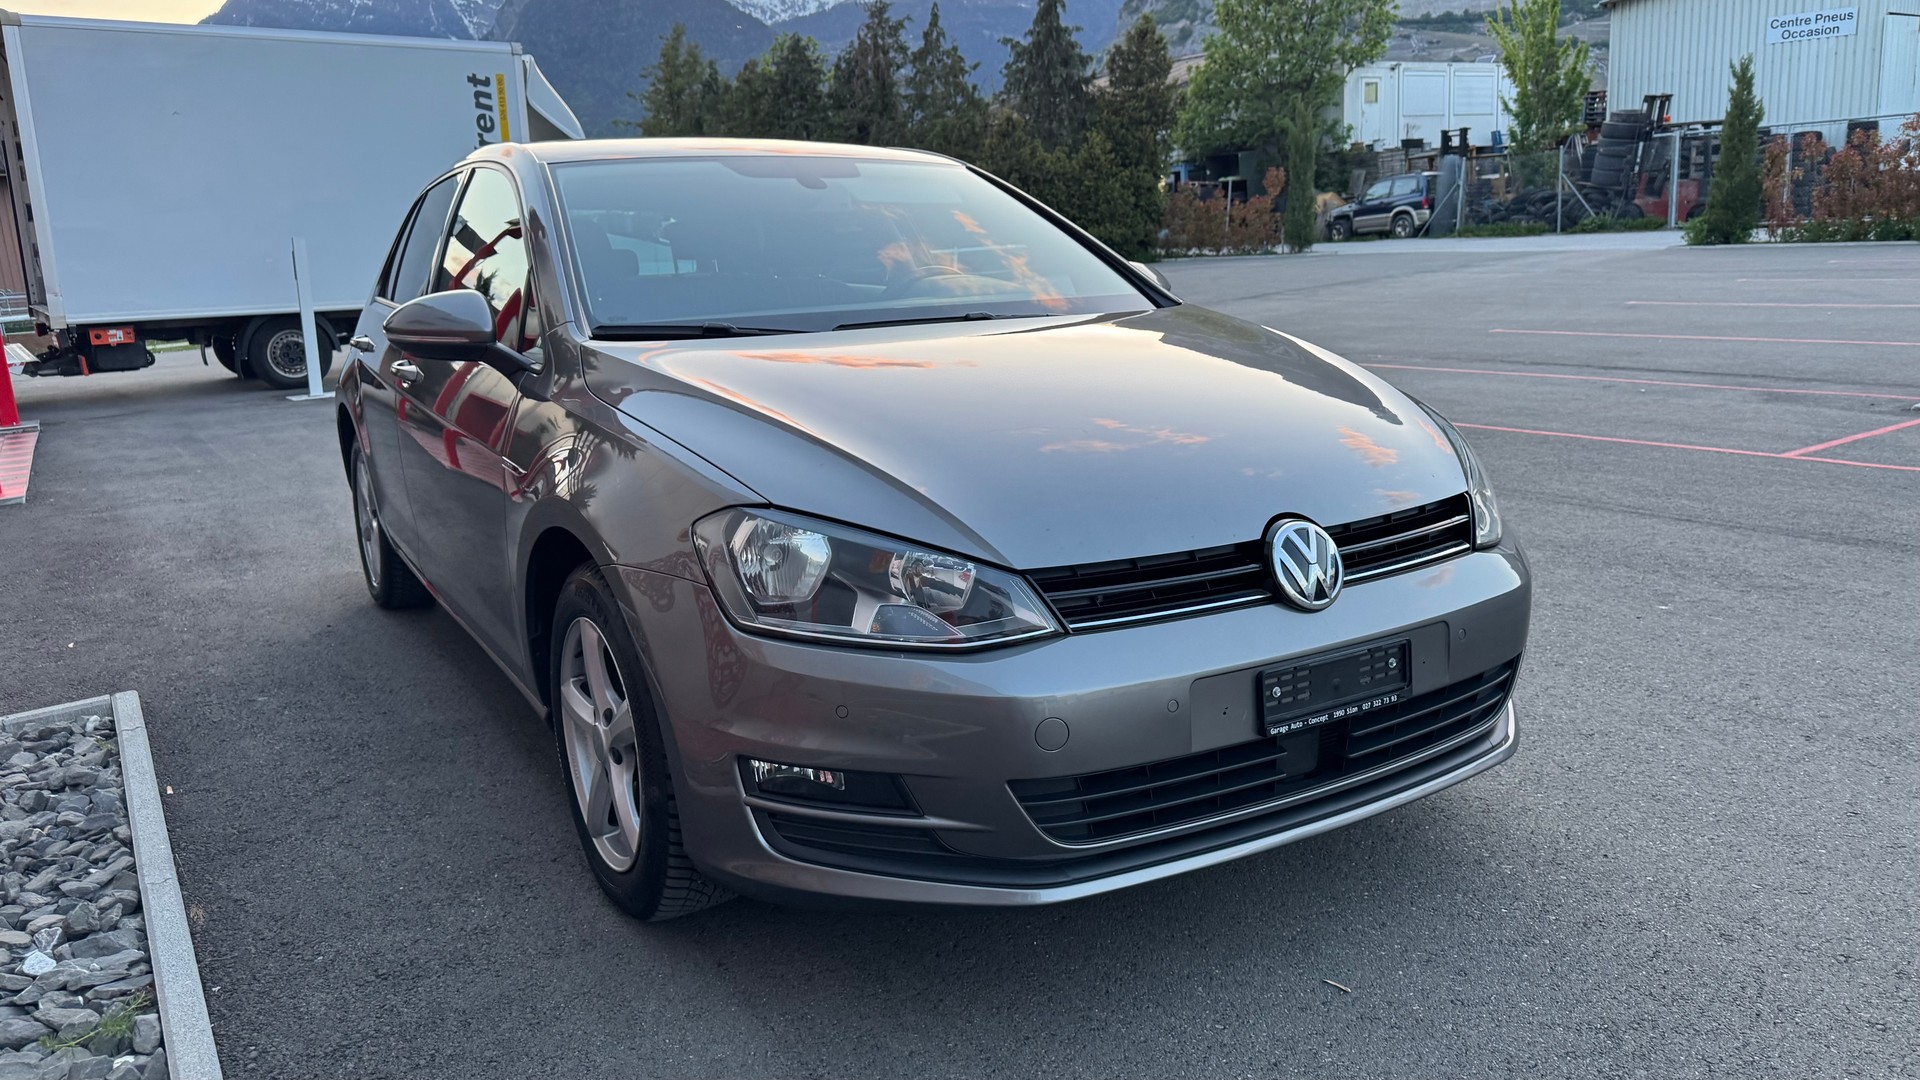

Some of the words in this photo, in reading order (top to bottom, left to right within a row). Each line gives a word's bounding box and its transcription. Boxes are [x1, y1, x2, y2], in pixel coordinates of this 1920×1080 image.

[1770, 17, 1812, 30] Centre
[1814, 11, 1854, 24] Pneus
[1781, 25, 1840, 40] Occasion
[467, 73, 497, 150] rent
[1275, 522, 1342, 606] VW
[1270, 725, 1289, 735] Garage
[1290, 721, 1303, 730] Auto
[1308, 714, 1329, 725] Concept
[1346, 706, 1358, 715] Sion
[1362, 702, 1371, 710] 027
[1372, 699, 1382, 708] 322
[1383, 696, 1390, 704] 73
[1391, 694, 1398, 702] 93
